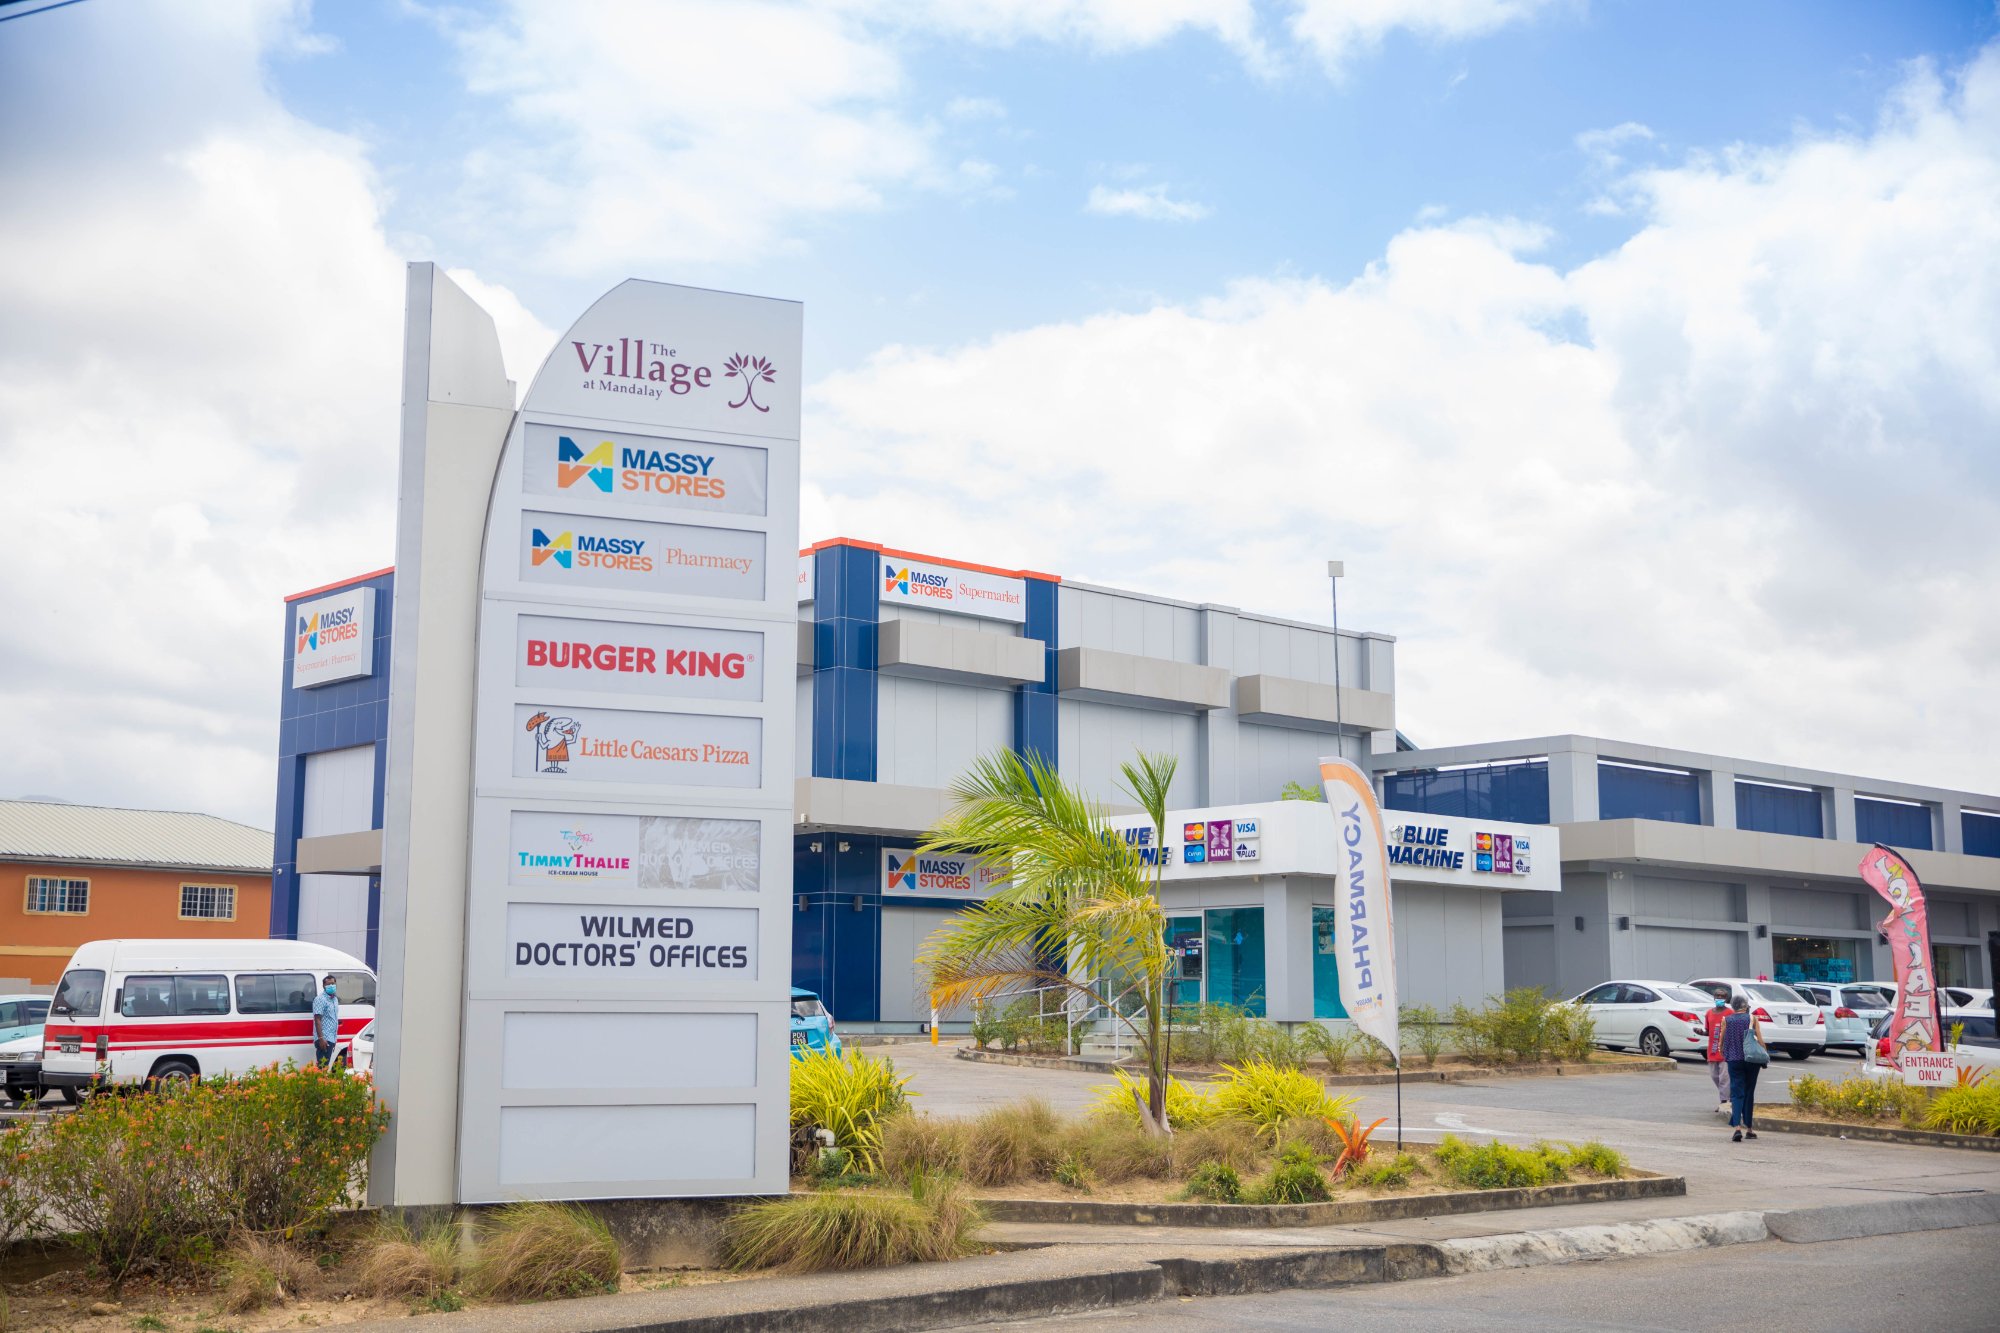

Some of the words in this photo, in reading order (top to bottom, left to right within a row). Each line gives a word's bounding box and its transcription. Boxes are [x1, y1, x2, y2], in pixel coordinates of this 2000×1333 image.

[650, 343, 676, 357] The
[571, 338, 712, 395] Village
[583, 380, 595, 390] at
[599, 380, 663, 400] Mandalay
[622, 447, 715, 476] MASSY
[621, 470, 726, 499] STORES
[578, 535, 646, 555] MASSY
[577, 551, 653, 572] STORES
[666, 548, 753, 574] Pharmacy
[911, 571, 949, 587] MASSY
[911, 583, 953, 600] STORES
[959, 583, 1020, 605] Supermarket
[320, 607, 354, 629] MASSY
[320, 622, 358, 645] STORES
[527, 639, 656, 674] BURGER
[666, 649, 745, 679] KING
[580, 737, 628, 759] Little
[630, 740, 699, 762] Caesars
[702, 743, 750, 765] Pizza
[1236, 823, 1256, 833] VISA
[1403, 825, 1448, 846] BLUE
[1210, 848, 1230, 857] LINX
[1241, 849, 1256, 858] PLUS
[1515, 840, 1530, 850] VISA
[580, 870, 599, 878] HOUSE
[919, 859, 966, 875] MASSY
[1496, 860, 1511, 869] LINX
[1519, 865, 1530, 873] PLUS
[919, 874, 971, 890] STORES
[580, 915, 694, 939] WILMED
[516, 940, 641, 967] DOCTORS'
[650, 944, 748, 968] OFFICES
[1905, 1056, 1954, 1069] ENTRANCE
[1918, 1069, 1942, 1082] ONLY
